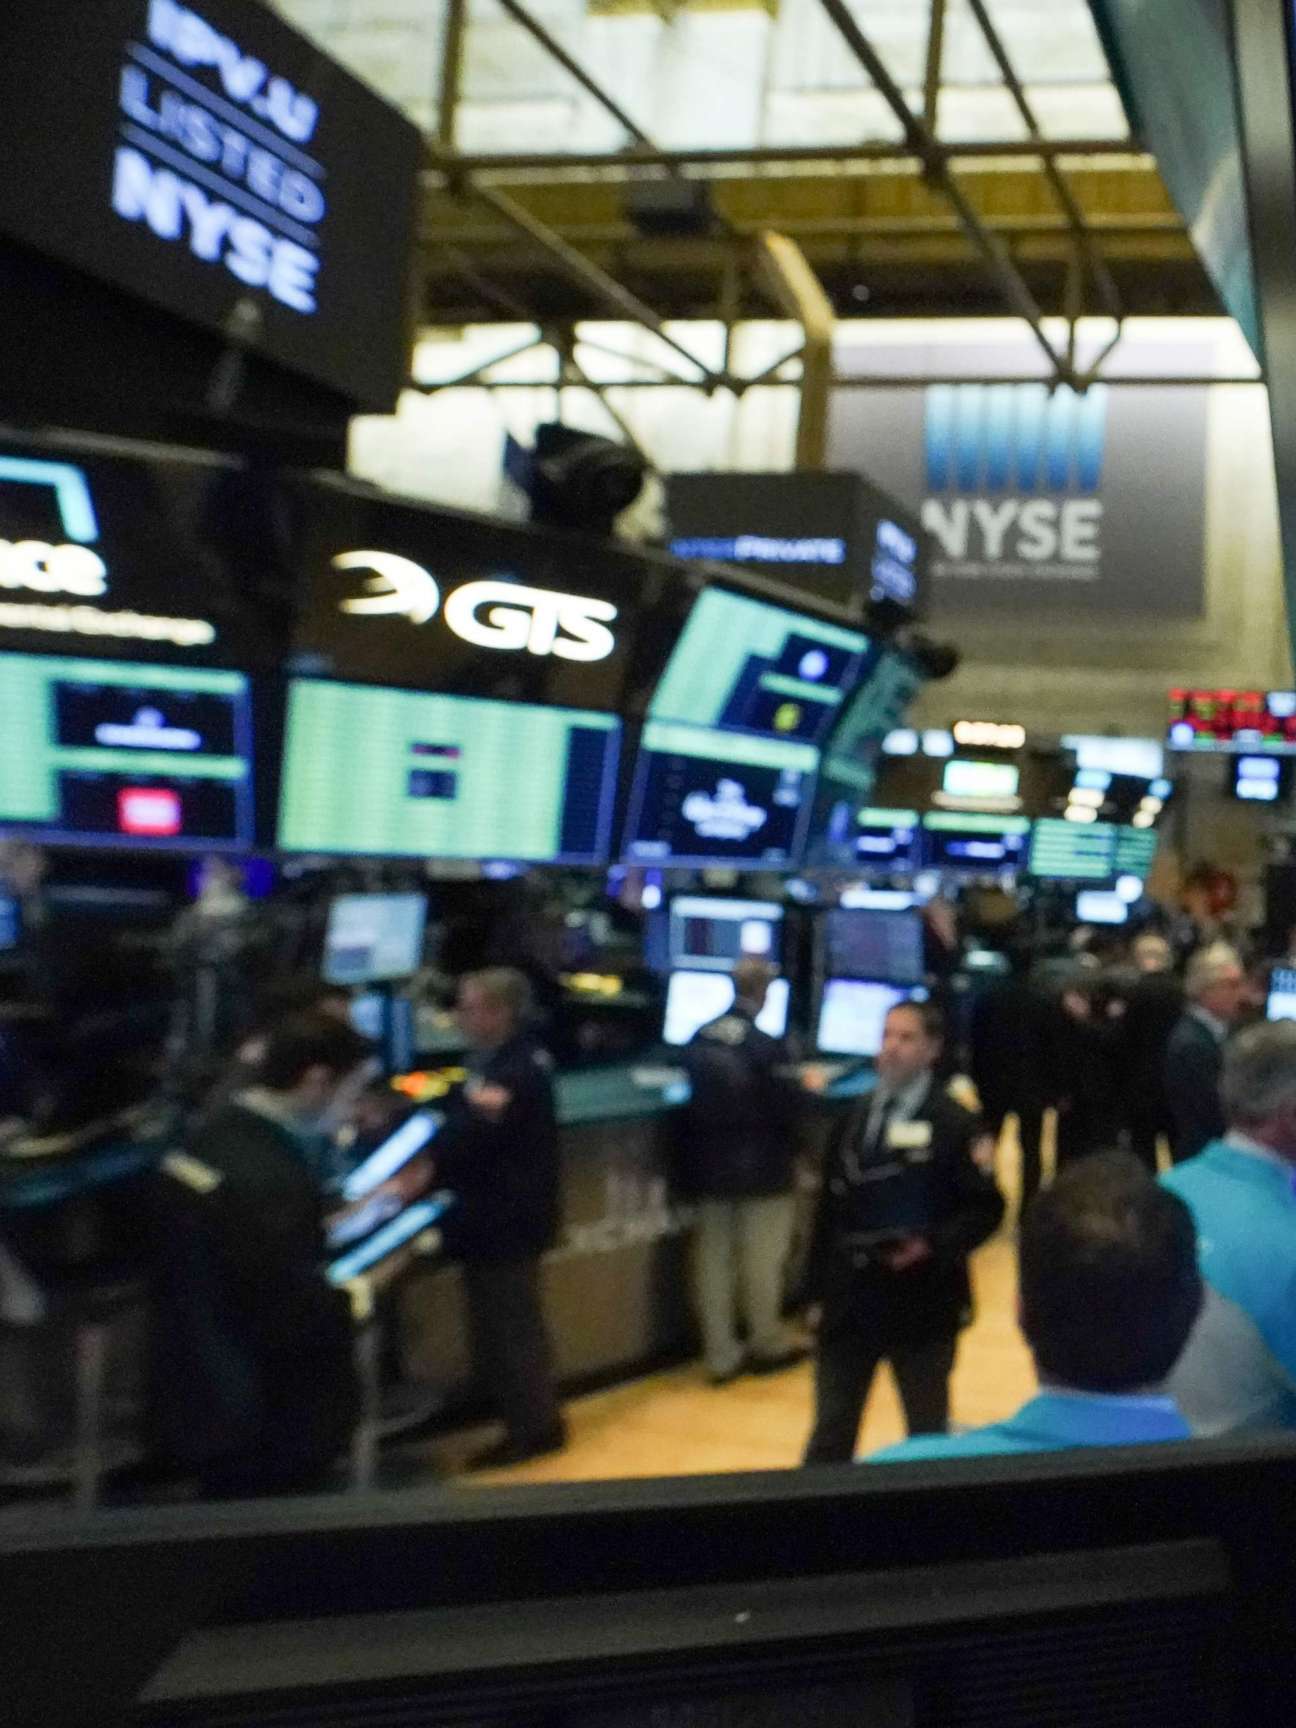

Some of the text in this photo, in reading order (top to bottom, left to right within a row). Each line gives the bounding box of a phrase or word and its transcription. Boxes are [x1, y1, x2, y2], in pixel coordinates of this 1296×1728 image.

[112, 147, 321, 315] NYSE
[921, 499, 1101, 560] NYSE
[444, 580, 618, 662] GTS
